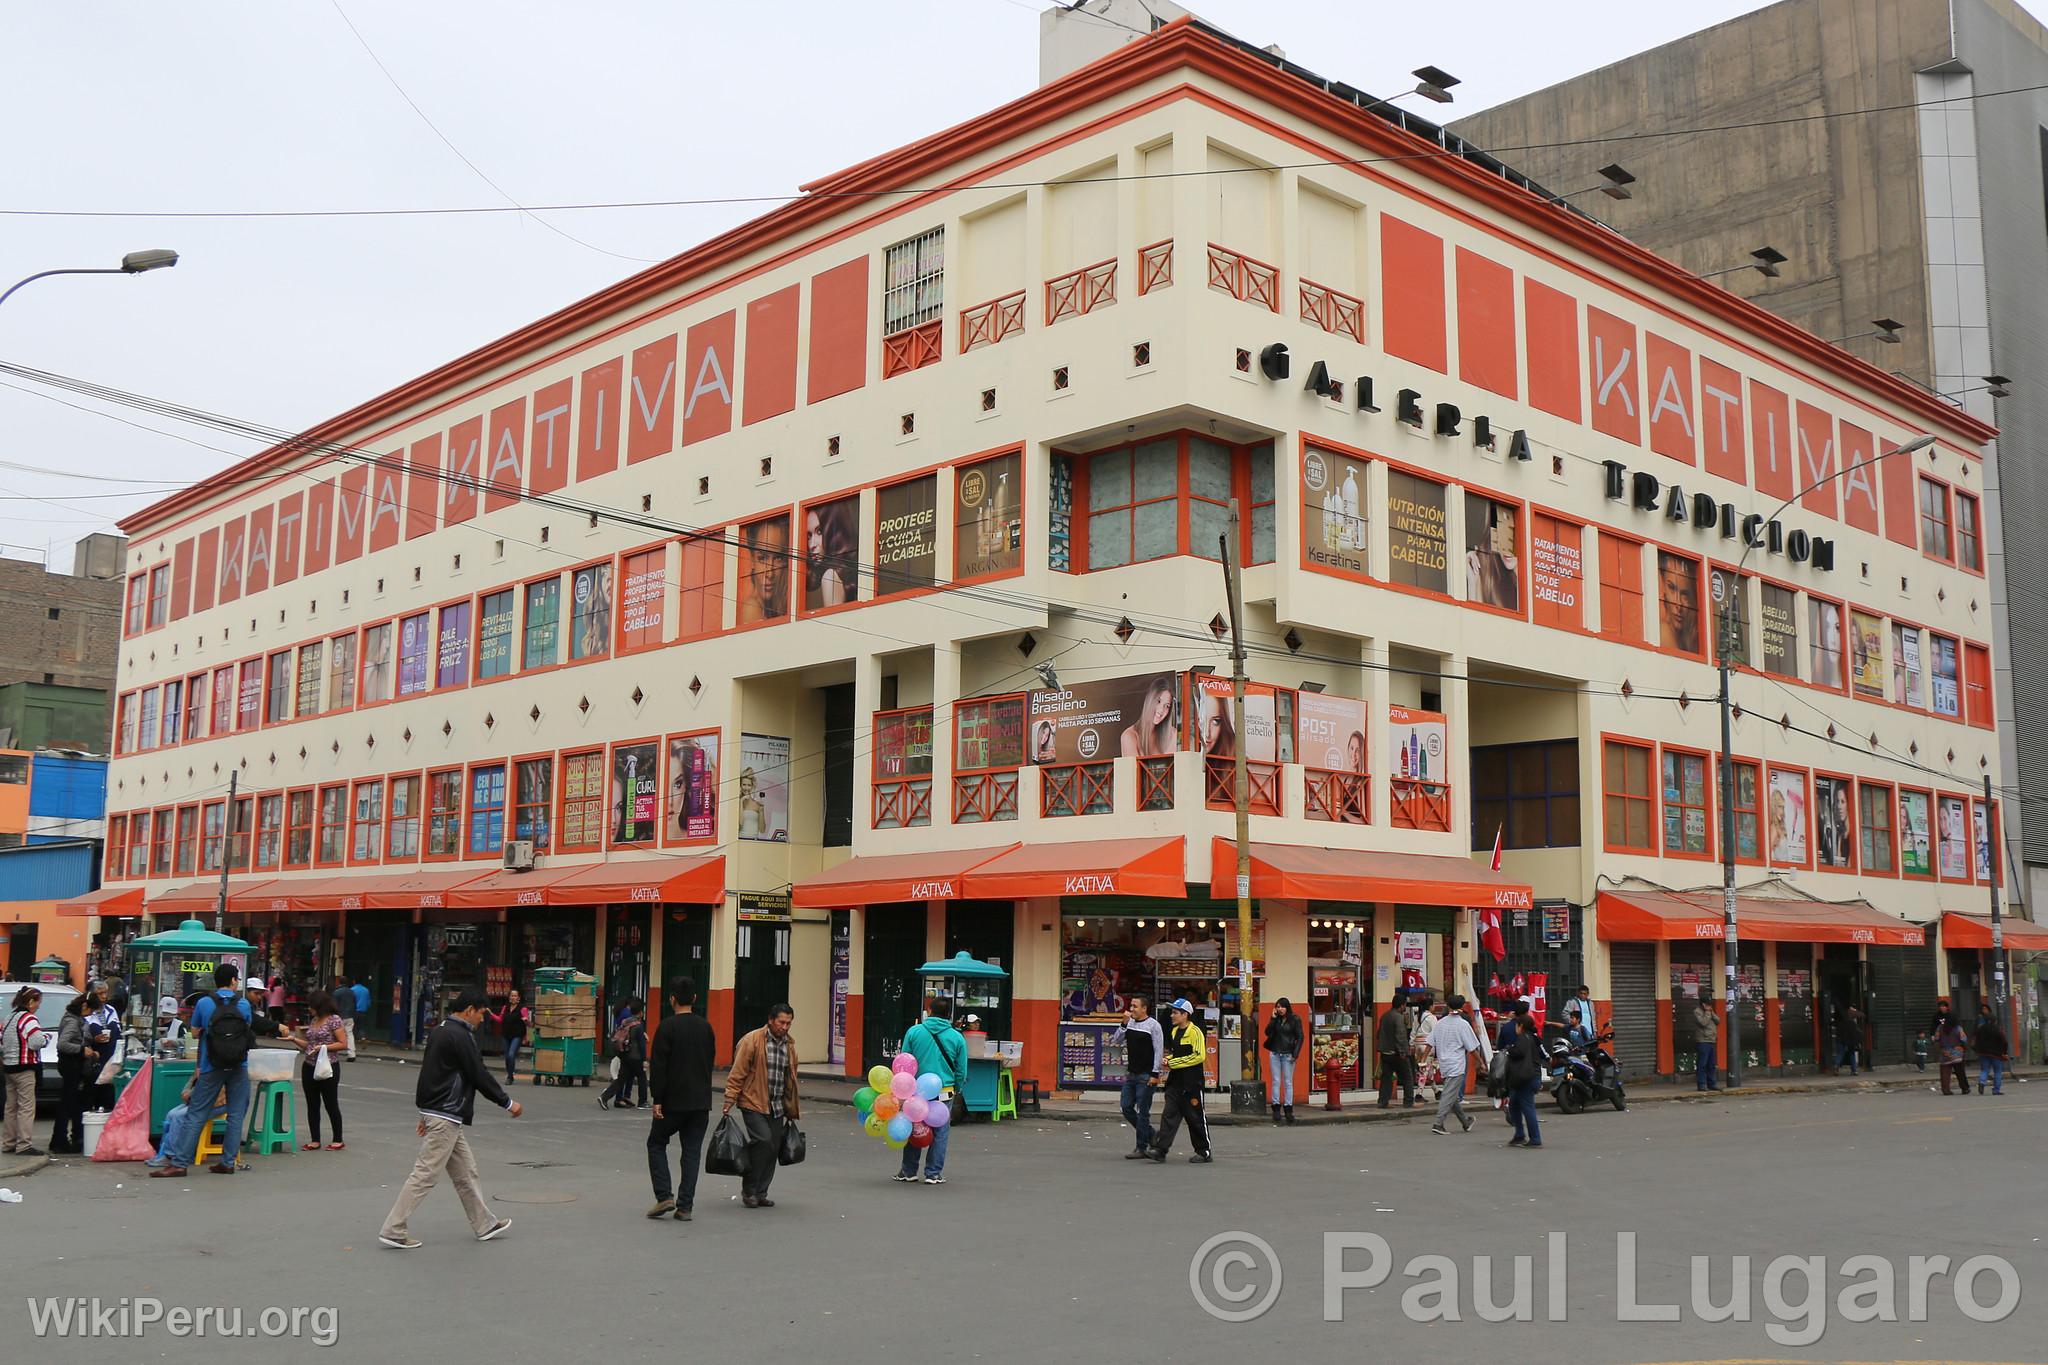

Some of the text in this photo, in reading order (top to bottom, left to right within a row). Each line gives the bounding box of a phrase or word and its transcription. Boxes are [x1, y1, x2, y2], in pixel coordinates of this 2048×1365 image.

[1260, 342, 1533, 463] GALERIA
[448, 345, 732, 505] KATIVA
[1594, 335, 1877, 513] KATIVA
[965, 477, 981, 487] LIBRE
[968, 484, 981, 495] SAL
[879, 509, 934, 535] PROTEGE
[1602, 459, 1834, 572] TRADICION
[221, 475, 400, 587] KATIVA
[1397, 515, 1446, 540] INTENSA
[886, 529, 922, 549] CUIDA
[1406, 536, 1446, 553] PARA TU
[879, 555, 891, 565] TU
[1308, 546, 1361, 571] Keratina
[1391, 545, 1446, 570] CABELLO
[1548, 577, 1560, 588] DE
[623, 613, 661, 632] CABELLO
[440, 627, 457, 641] DILE
[1204, 680, 1232, 692] KATIVA
[1033, 690, 1073, 704] Alisado
[1058, 720, 1077, 728] HASTA
[1094, 714, 1121, 725] SEMANAS
[1300, 717, 1337, 737] POST
[1246, 725, 1273, 738] cabello
[636, 780, 656, 793] CURL
[911, 880, 954, 898] KATIVA
[1064, 875, 1115, 893] KATIVA
[420, 895, 442, 907] KATIVA
[517, 891, 542, 904] KATIVA
[630, 887, 661, 901] KATIVA
[1494, 889, 1530, 907] KATIVA
[1695, 923, 1723, 937] KATIVA
[1852, 928, 1874, 941] KATIVA
[1903, 931, 1923, 945] KATIVA
[183, 962, 211, 972] SOYA
